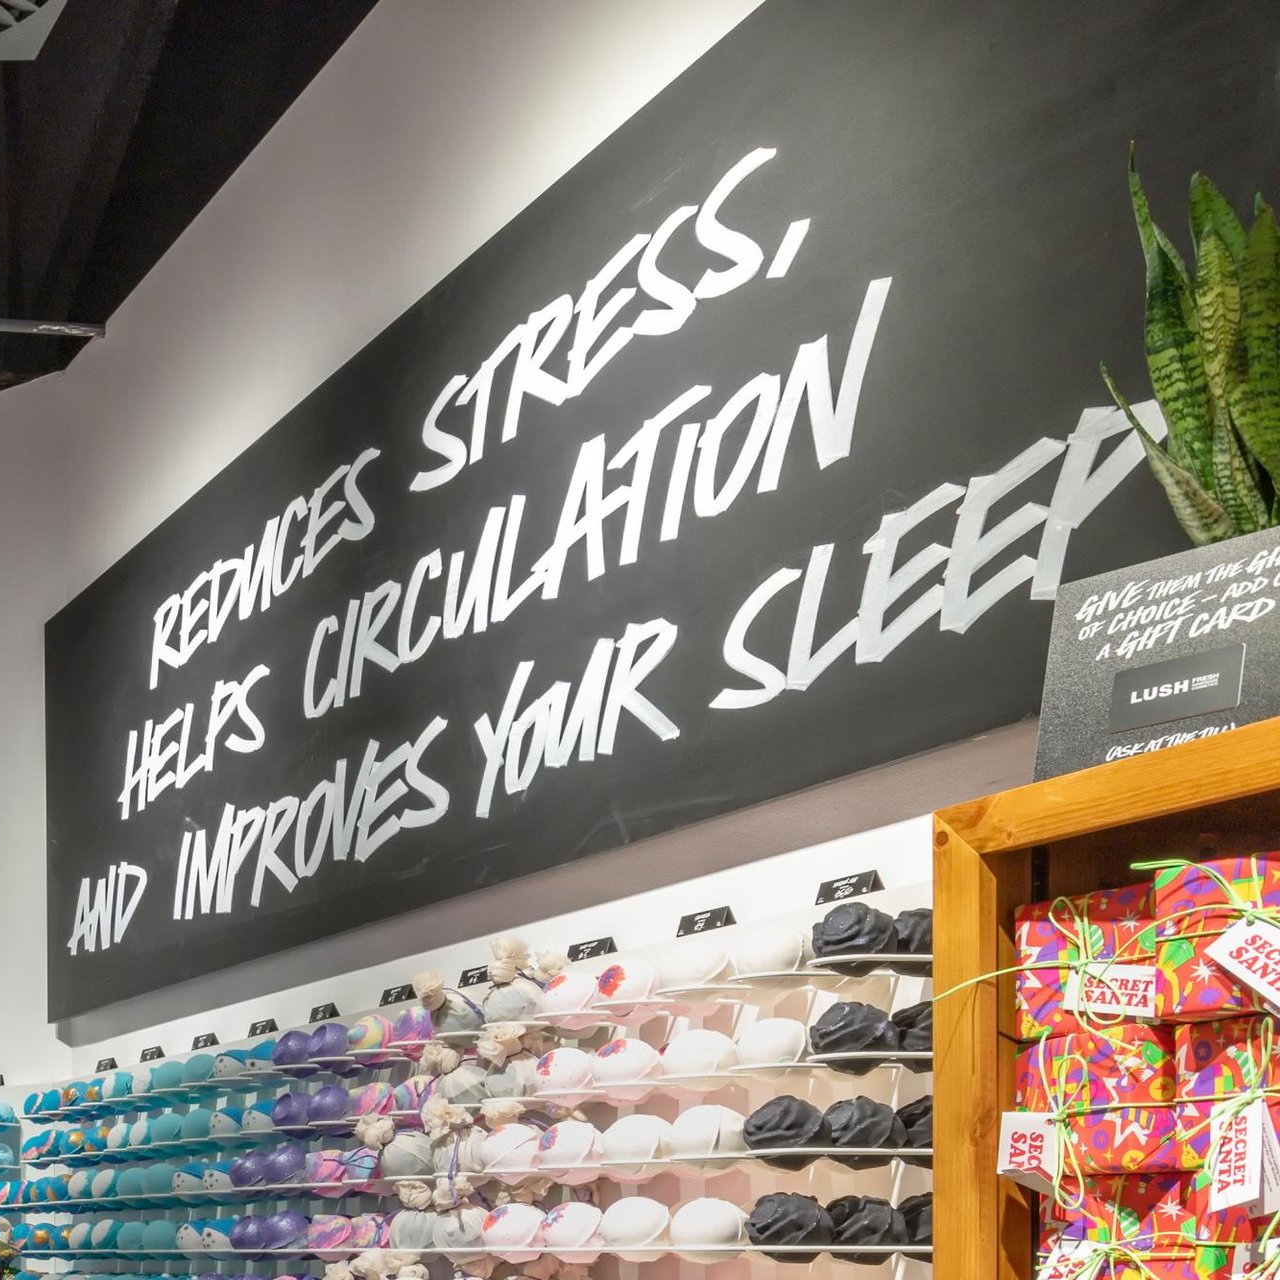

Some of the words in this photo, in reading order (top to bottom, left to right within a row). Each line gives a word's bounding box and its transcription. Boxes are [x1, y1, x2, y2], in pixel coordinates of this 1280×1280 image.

[149, 449, 380, 690] REDUCES
[409, 146, 815, 493] STRESS,
[118, 664, 270, 820] HELPS
[303, 276, 893, 719] CIRCULATION
[1075, 579, 1150, 623] GIVE
[1146, 572, 1202, 600] THEM
[1205, 557, 1248, 584] THE
[1246, 546, 1280, 576] GI
[1078, 623, 1107, 641] OF
[1107, 589, 1201, 635] CHOICE
[1219, 576, 1269, 603] ADD
[1096, 643, 1115, 661] A
[1115, 614, 1194, 660] GIFT
[1189, 597, 1276, 639] CARD
[68, 861, 147, 956] AND
[173, 716, 450, 920] IMPROVES
[474, 617, 682, 819] YOUR
[708, 399, 1168, 711] SLEEP
[1130, 679, 1189, 704] LUSH
[1191, 672, 1220, 685] FRESH
[1083, 990, 1149, 1009] SANTA
[1084, 976, 1154, 993] SECRET
[1217, 1120, 1233, 1194] SANTA
[1231, 1115, 1247, 1187] SECRET
